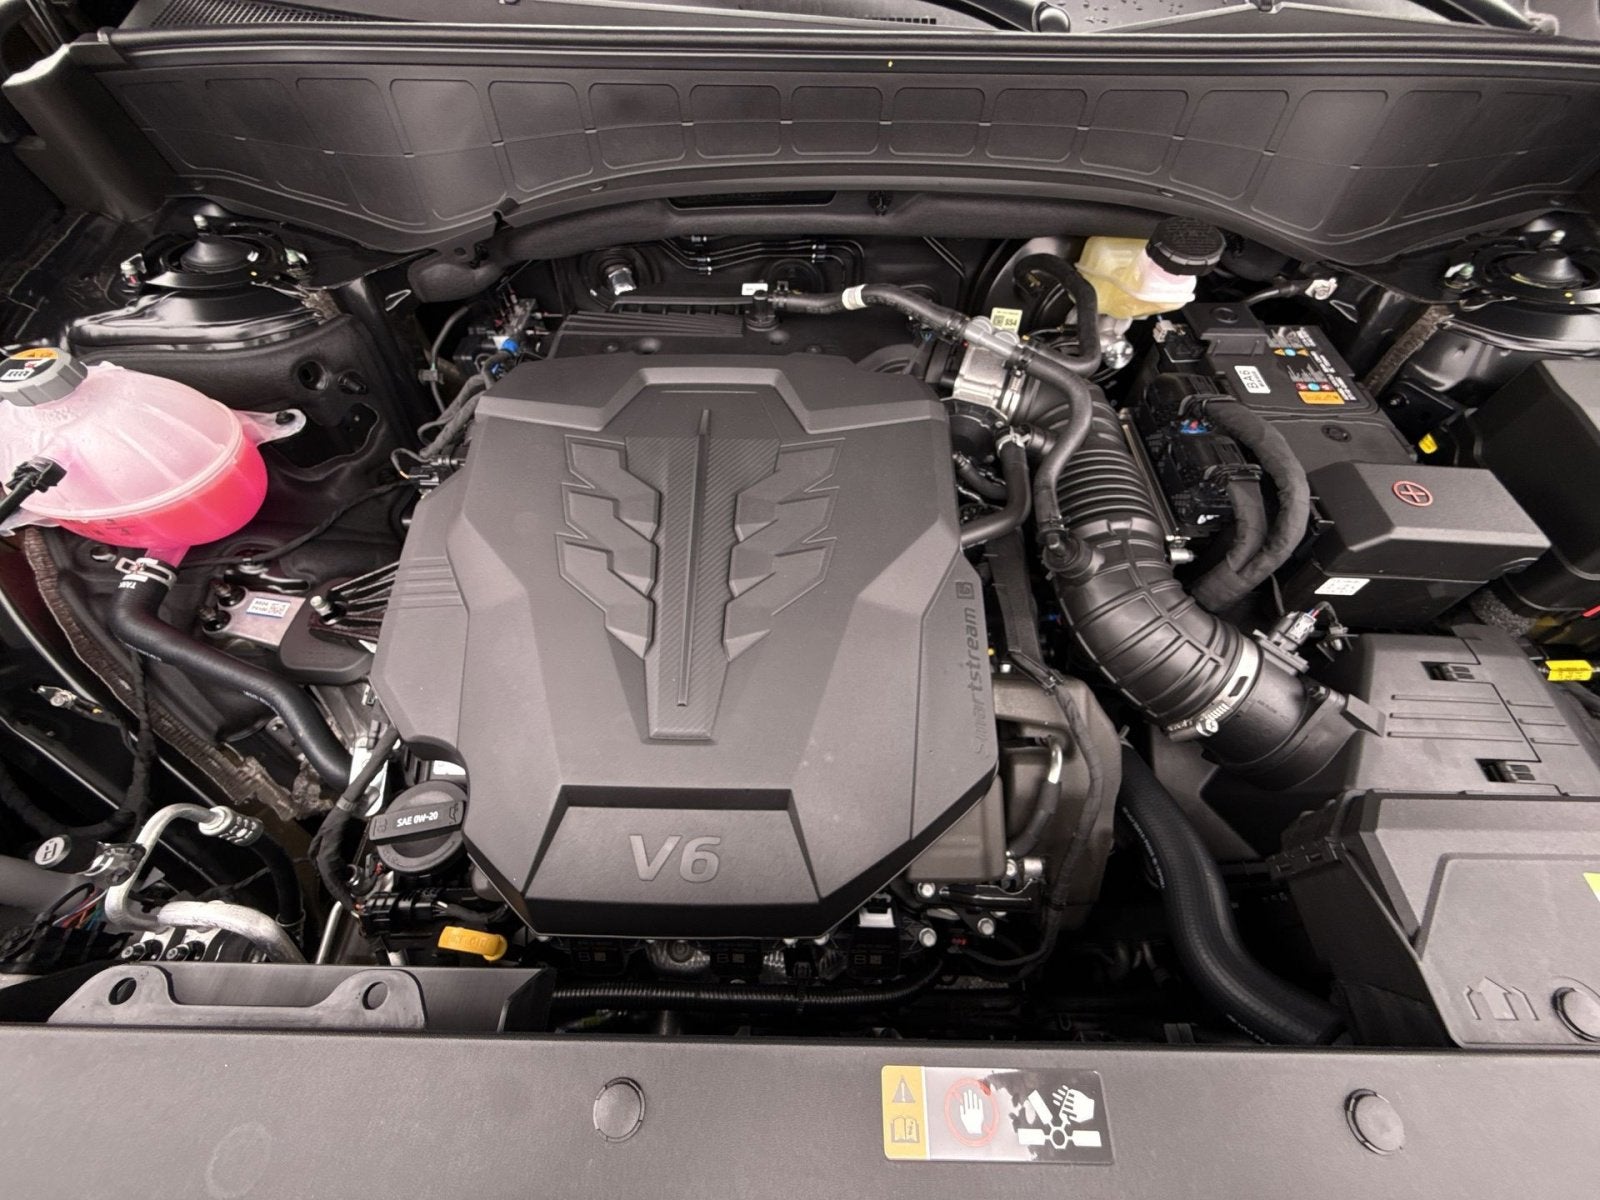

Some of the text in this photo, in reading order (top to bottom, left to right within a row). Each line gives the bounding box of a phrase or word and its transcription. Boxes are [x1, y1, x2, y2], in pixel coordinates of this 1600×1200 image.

[396, 810, 439, 828] SAE 0W-20
[629, 834, 721, 883] V6
